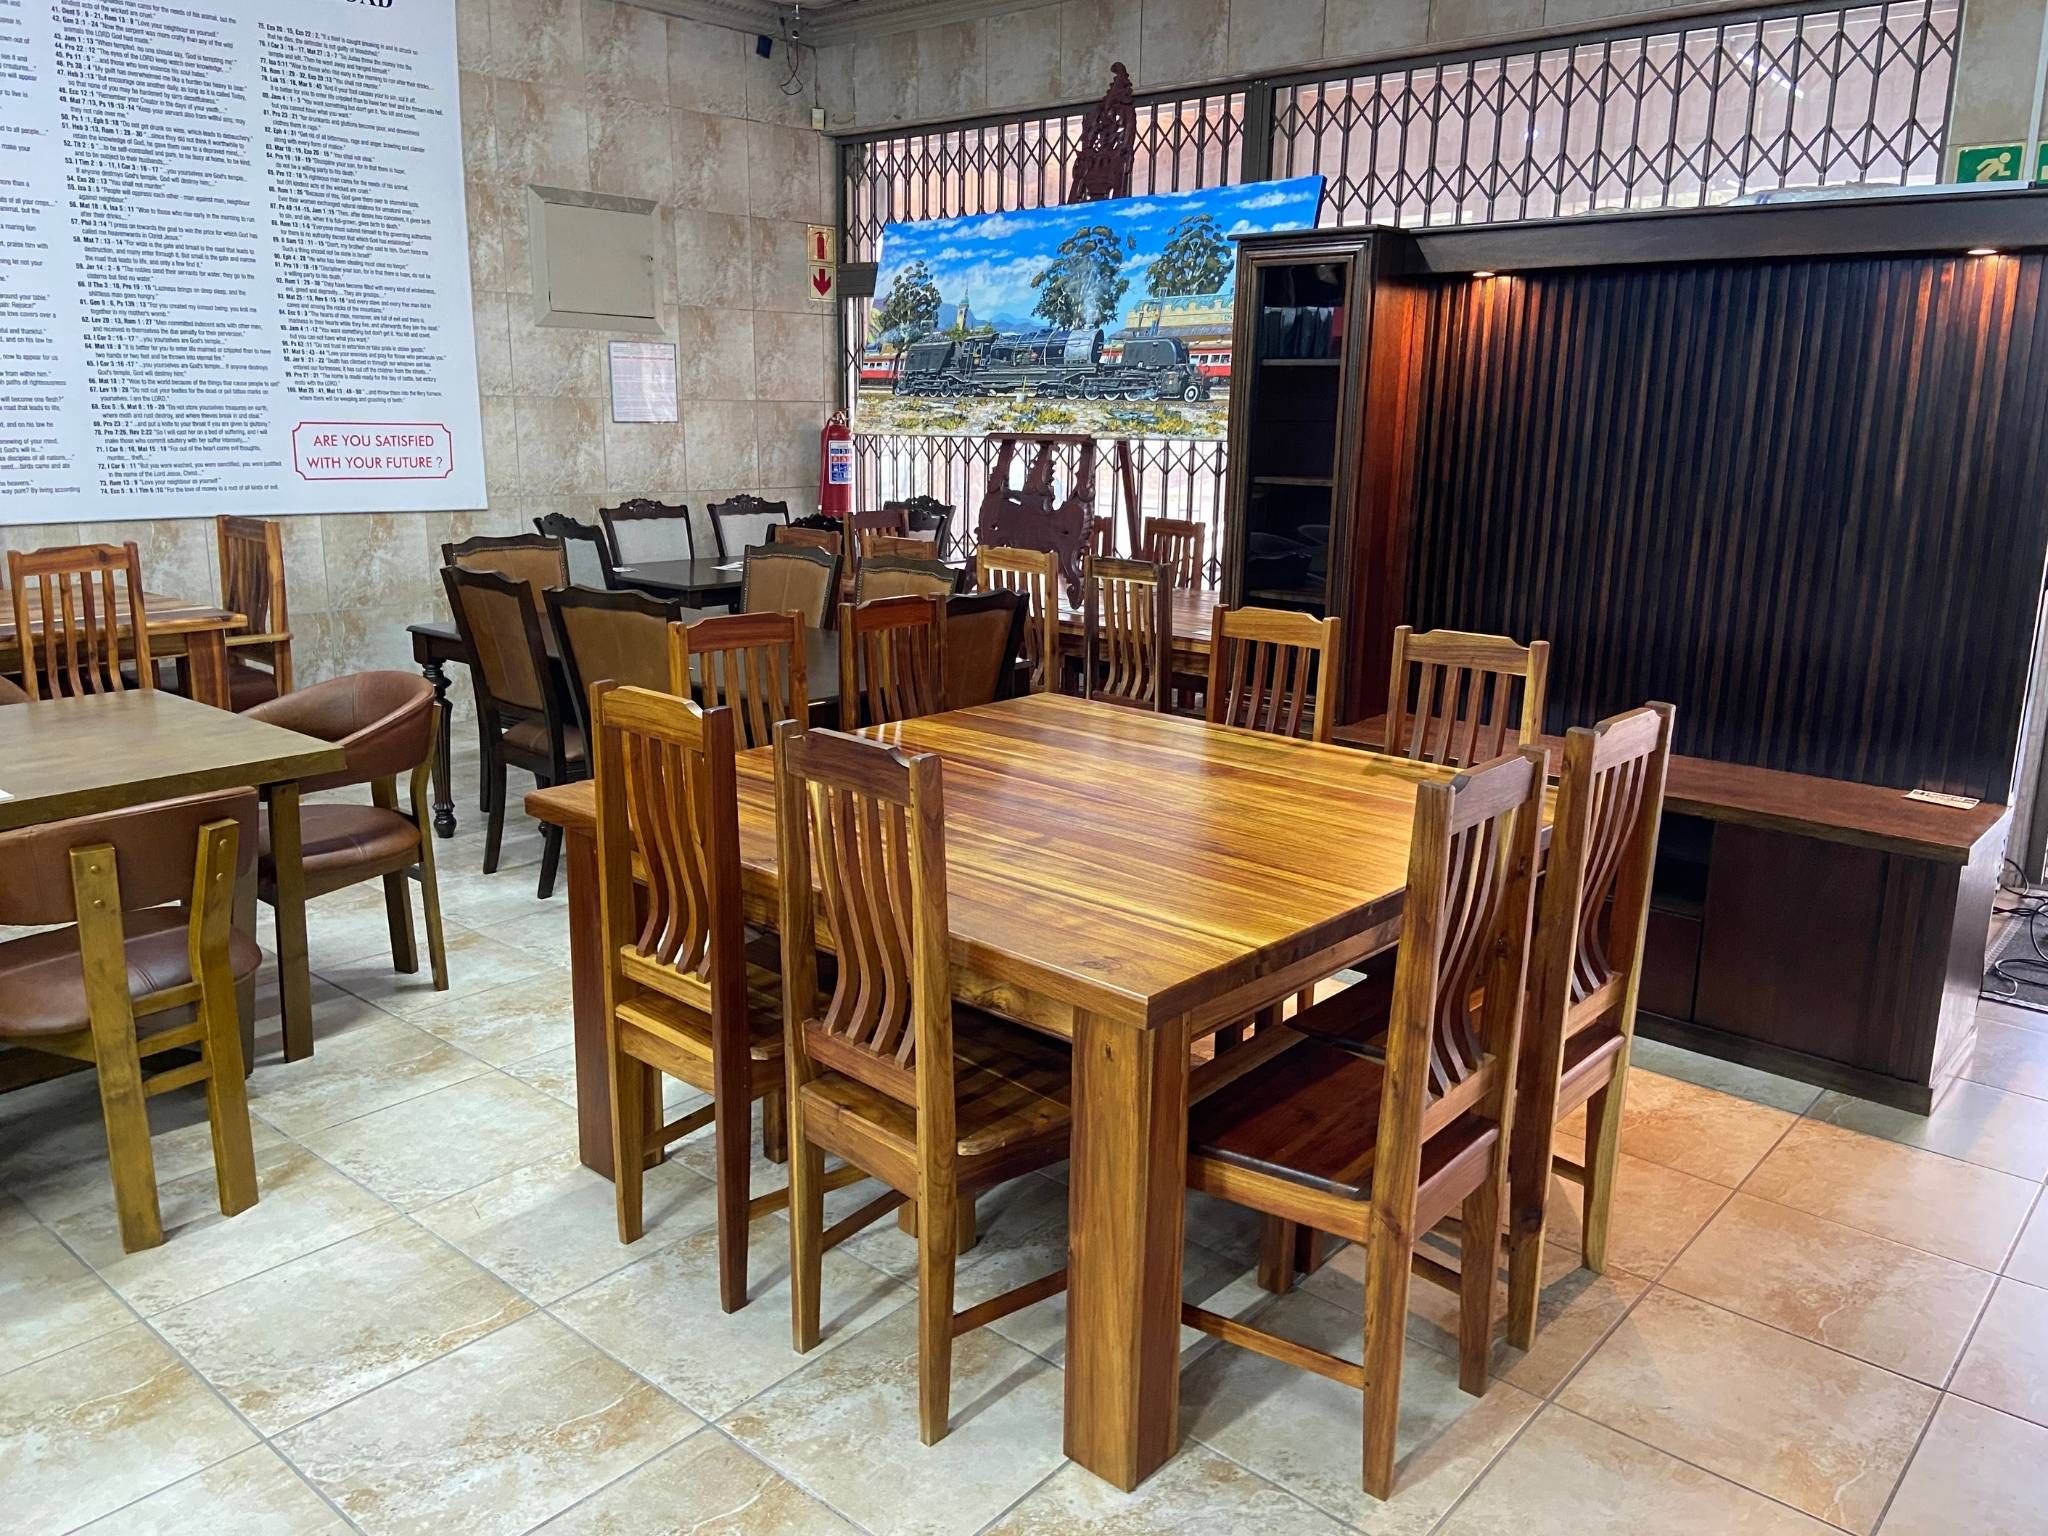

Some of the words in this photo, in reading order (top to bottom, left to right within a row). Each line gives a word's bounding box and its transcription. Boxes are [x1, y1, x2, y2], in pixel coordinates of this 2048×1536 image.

[313, 434, 337, 446] ARE
[342, 434, 370, 446] YOU
[374, 434, 434, 446] SATISFIED
[306, 456, 341, 468] WITH
[345, 456, 381, 468] YOUR
[385, 456, 432, 468] FUTURE
[436, 456, 442, 468] ?
